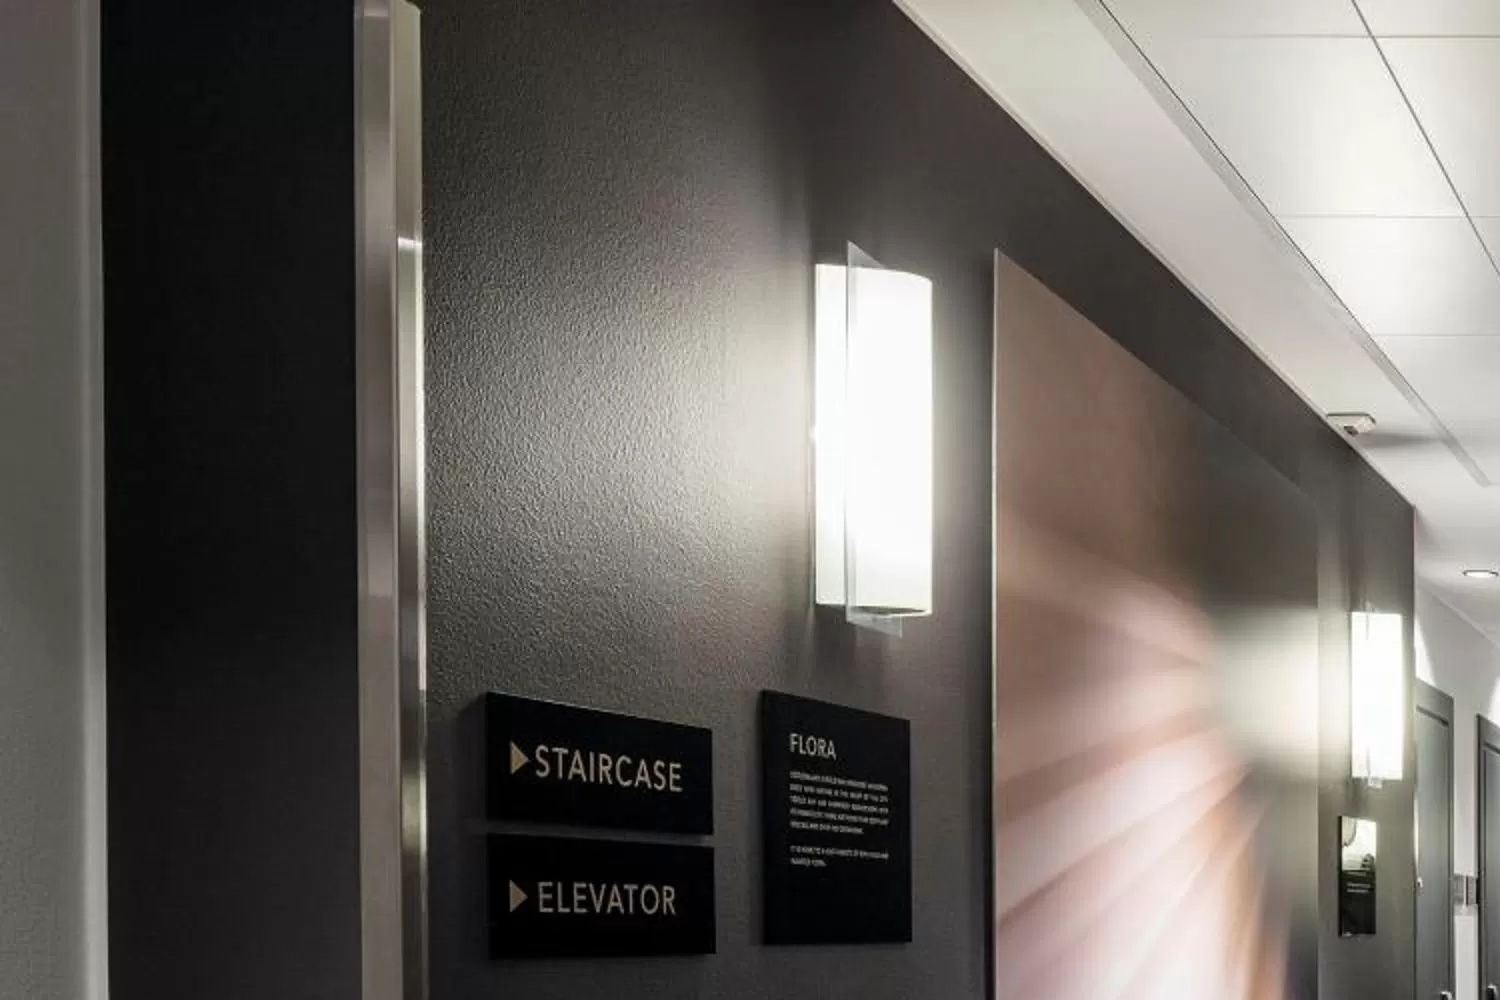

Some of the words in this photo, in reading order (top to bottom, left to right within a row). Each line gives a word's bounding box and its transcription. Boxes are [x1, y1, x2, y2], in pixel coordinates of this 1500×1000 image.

[789, 732, 837, 760] FLORA
[535, 744, 683, 792] STAIRCASE
[537, 881, 677, 916] ELEVATOR
